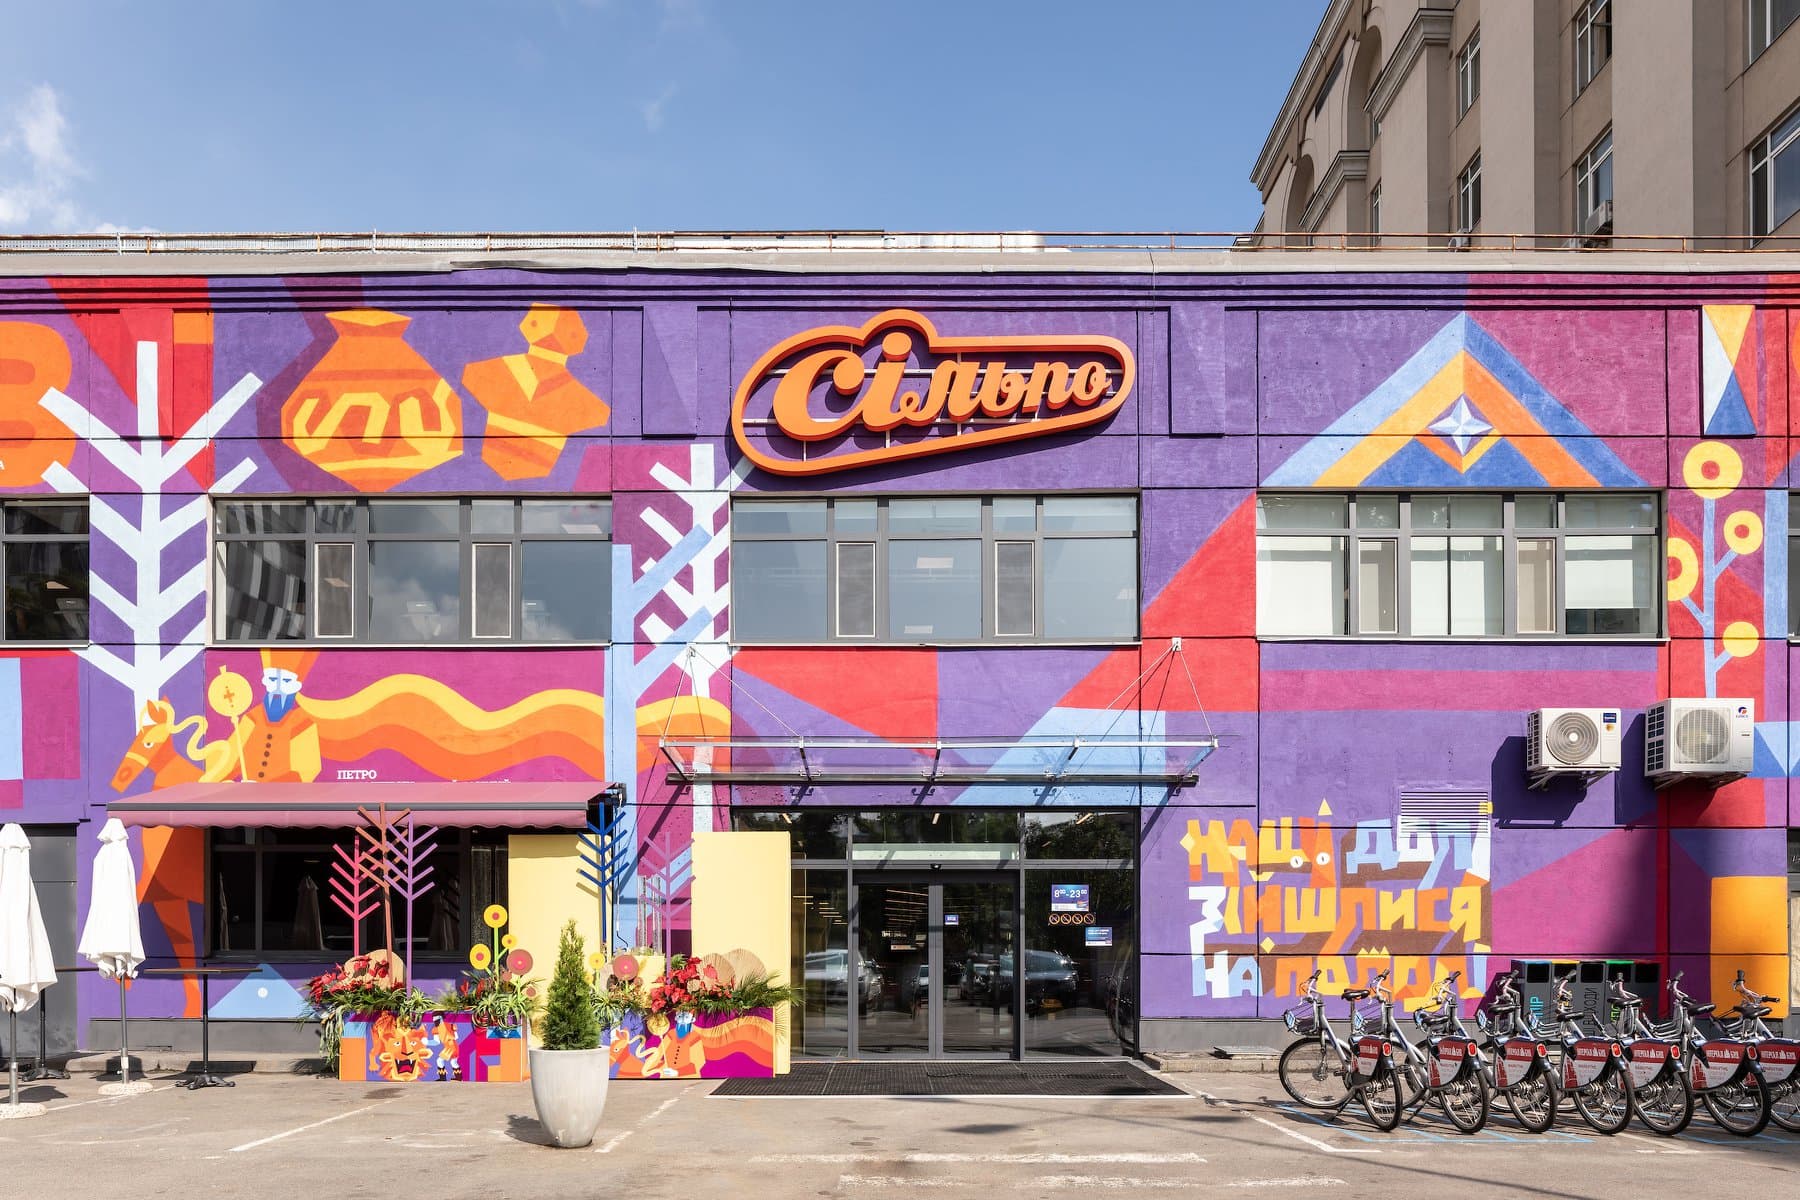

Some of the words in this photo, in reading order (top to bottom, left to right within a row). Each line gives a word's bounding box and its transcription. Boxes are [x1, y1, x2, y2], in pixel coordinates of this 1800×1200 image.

[773, 332, 1113, 441] Сільпо
[337, 769, 377, 780] ПЕТРО
[1192, 950, 1264, 999] НА
